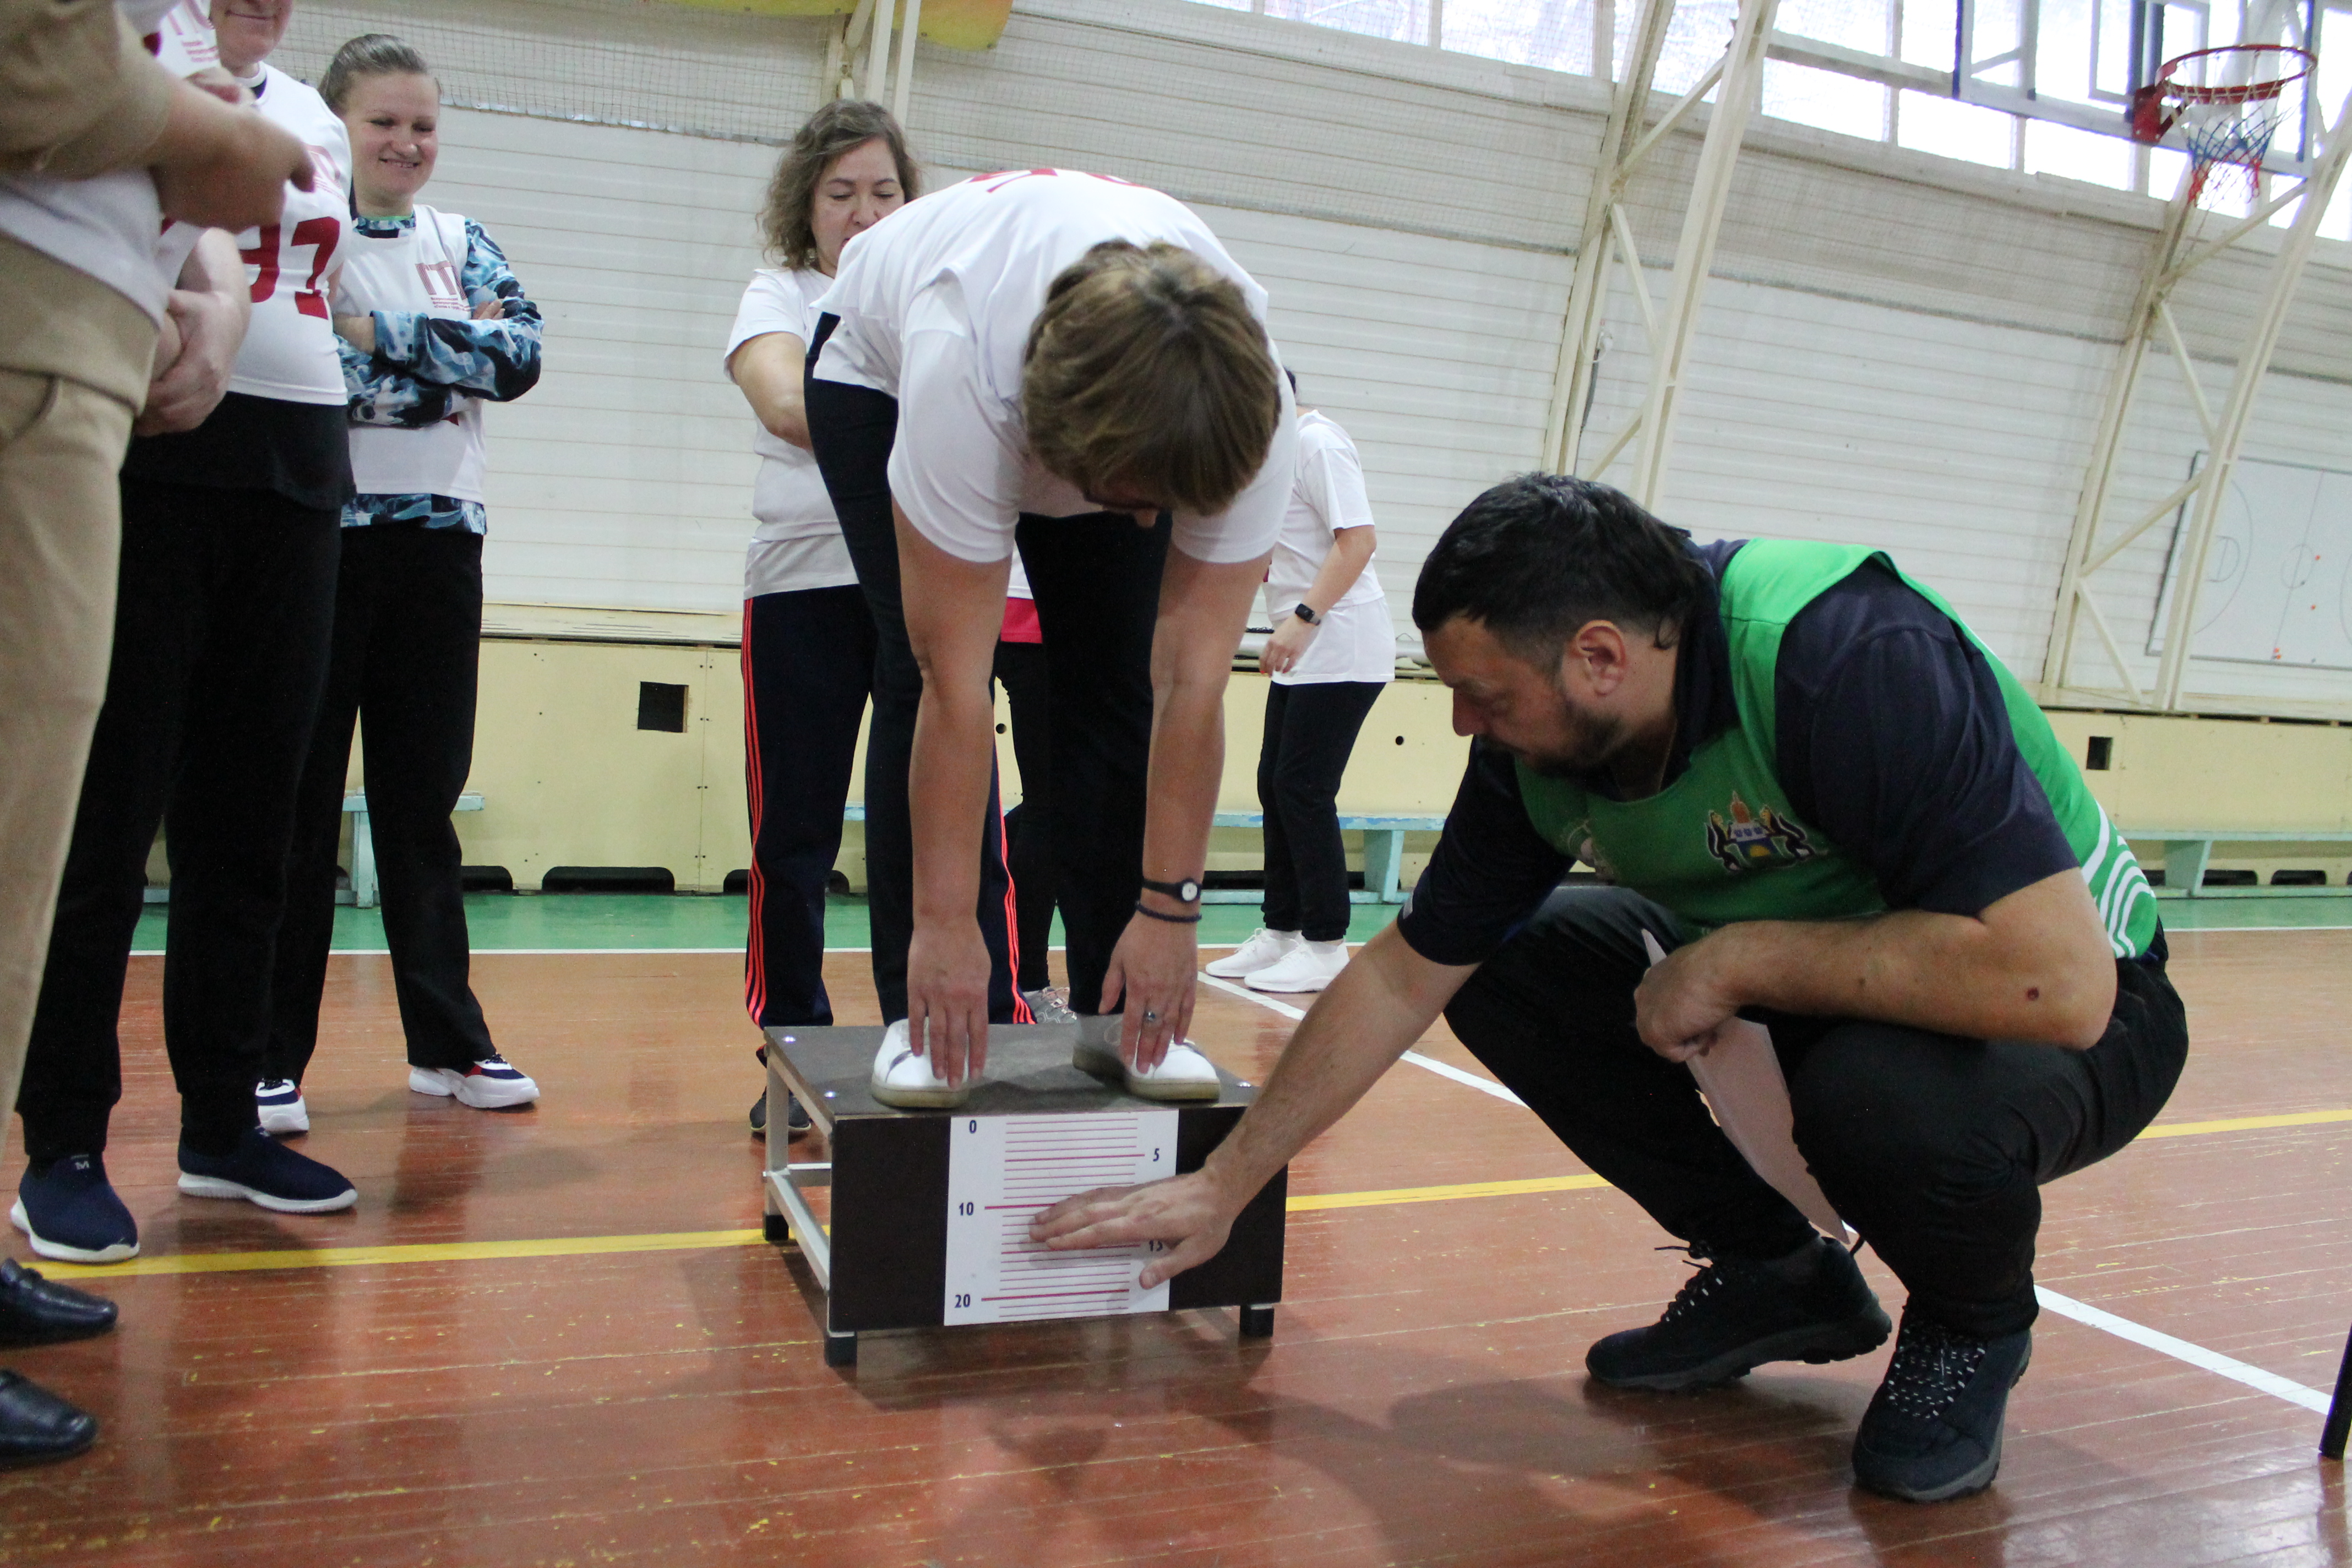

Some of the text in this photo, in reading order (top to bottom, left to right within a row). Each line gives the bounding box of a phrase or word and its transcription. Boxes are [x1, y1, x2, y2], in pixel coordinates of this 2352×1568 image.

[969, 1119, 977, 1134] 0
[1153, 1148, 1159, 1162] 5
[959, 1202, 974, 1216] 10
[954, 1294, 970, 1308] 20
